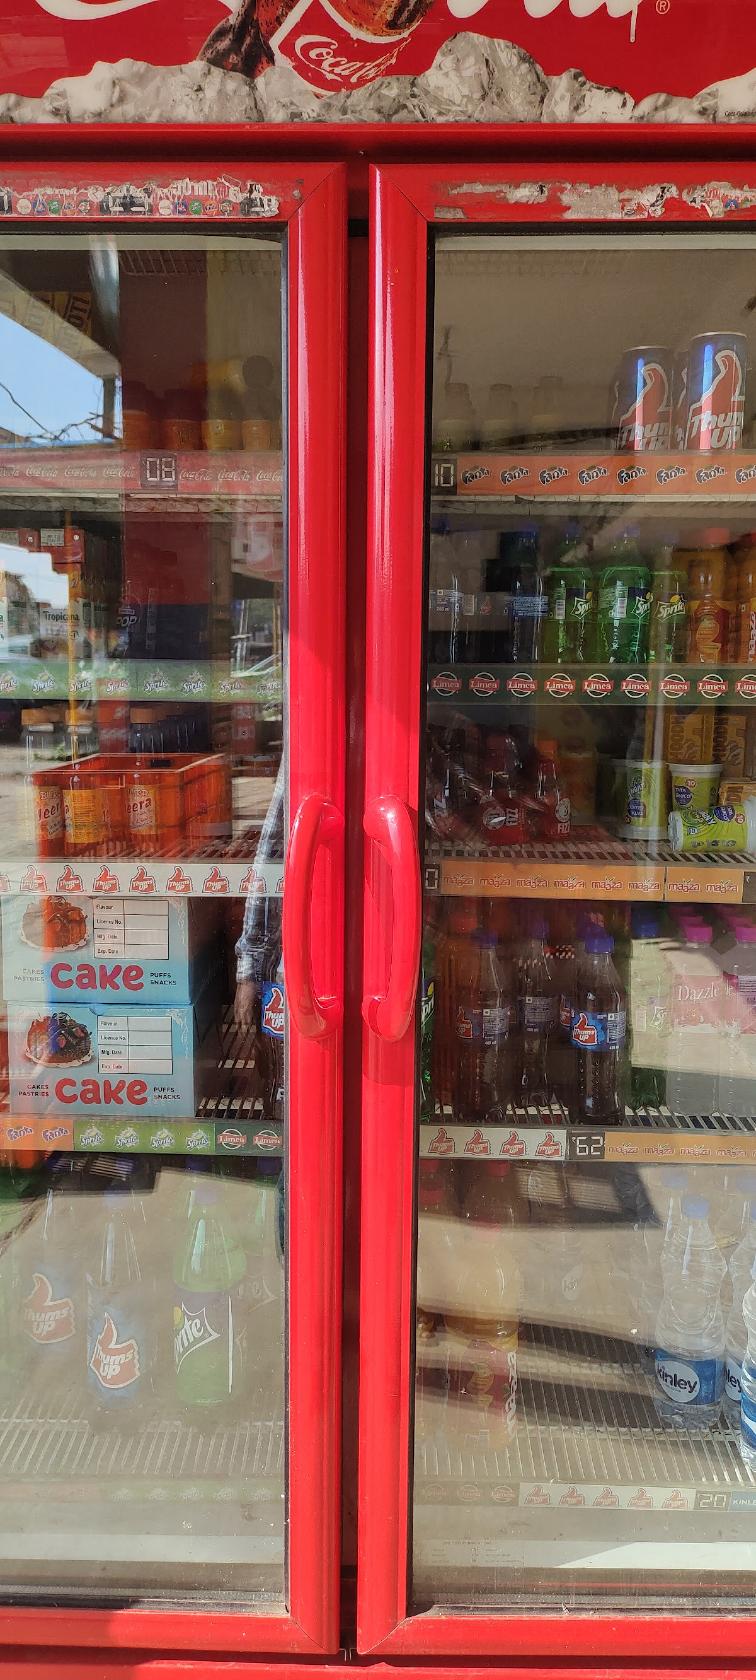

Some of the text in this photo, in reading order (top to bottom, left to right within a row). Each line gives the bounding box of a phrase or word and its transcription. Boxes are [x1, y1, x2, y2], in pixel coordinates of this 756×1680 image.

[435, 463, 454, 487] 10
[44, 610, 79, 621] Tropicana
[431, 680, 460, 689] Limca
[470, 680, 498, 689] Limca
[507, 681, 536, 690] Limca
[546, 681, 574, 690] Limca
[583, 682, 612, 690] Limca
[622, 682, 650, 690] Limca
[660, 682, 688, 690] Limca
[699, 682, 726, 691] Limca
[50, 962, 145, 992] cake
[55, 1078, 148, 1106] cake
[7, 1125, 70, 1142] Fanta Fanta
[576, 1136, 603, 1155] 62
[656, 1363, 698, 1393] kinley
